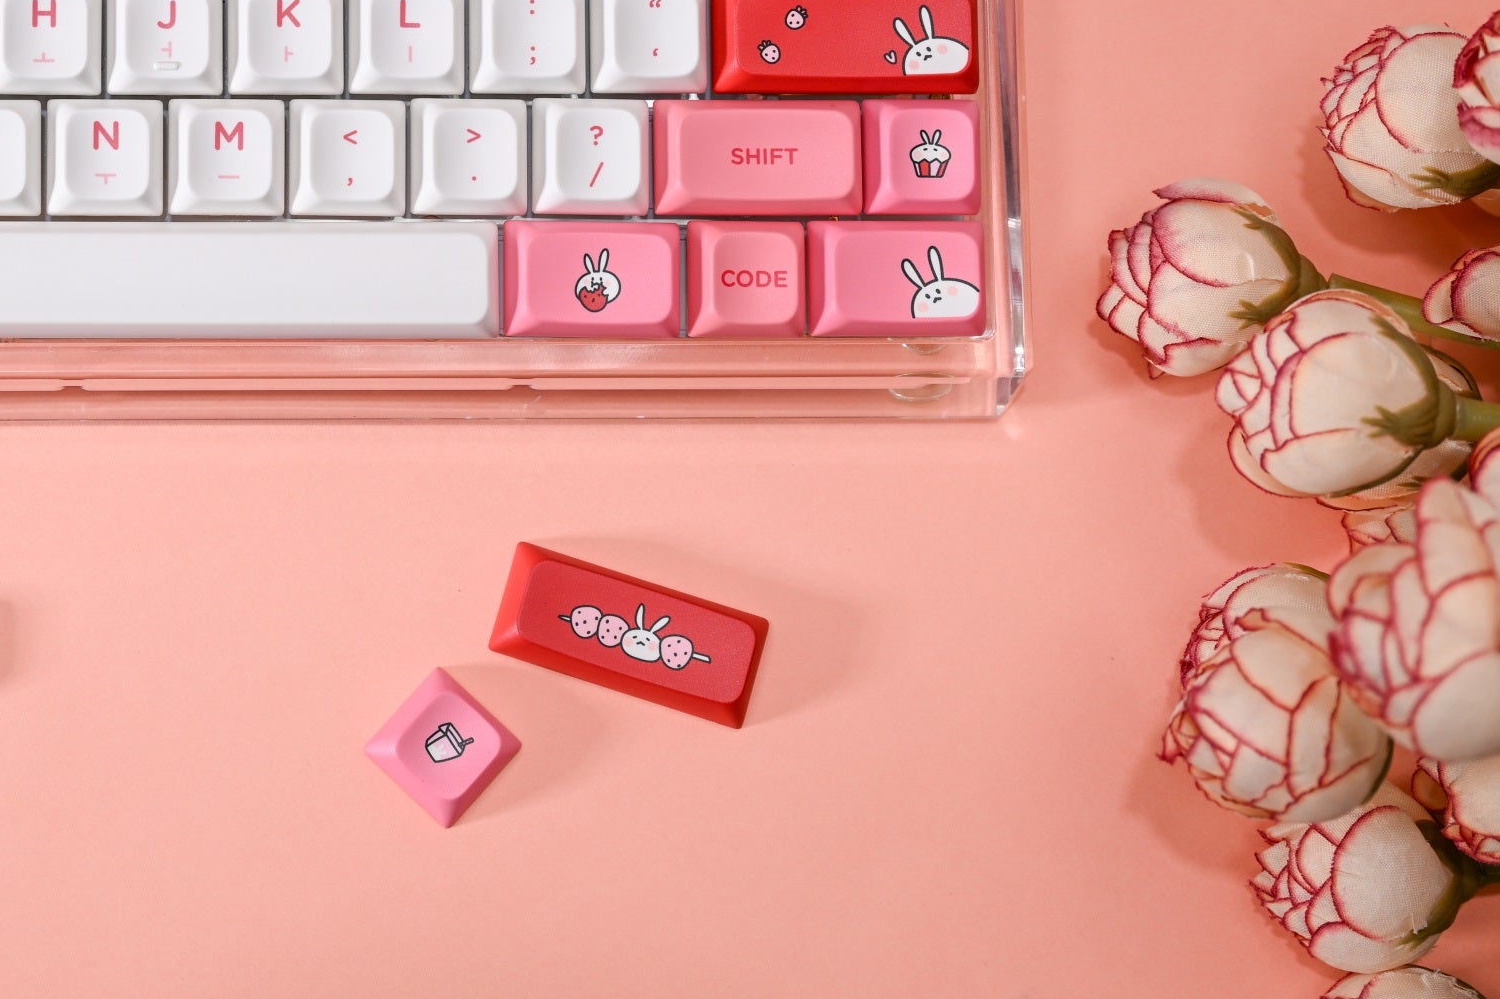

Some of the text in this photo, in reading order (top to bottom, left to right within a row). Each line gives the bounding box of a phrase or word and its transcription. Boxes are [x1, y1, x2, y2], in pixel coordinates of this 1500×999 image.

[156, 0, 177, 30] J
[92, 120, 120, 151] N
[214, 121, 244, 151] M
[730, 147, 799, 166] SHIFT
[720, 269, 787, 288] CODE
